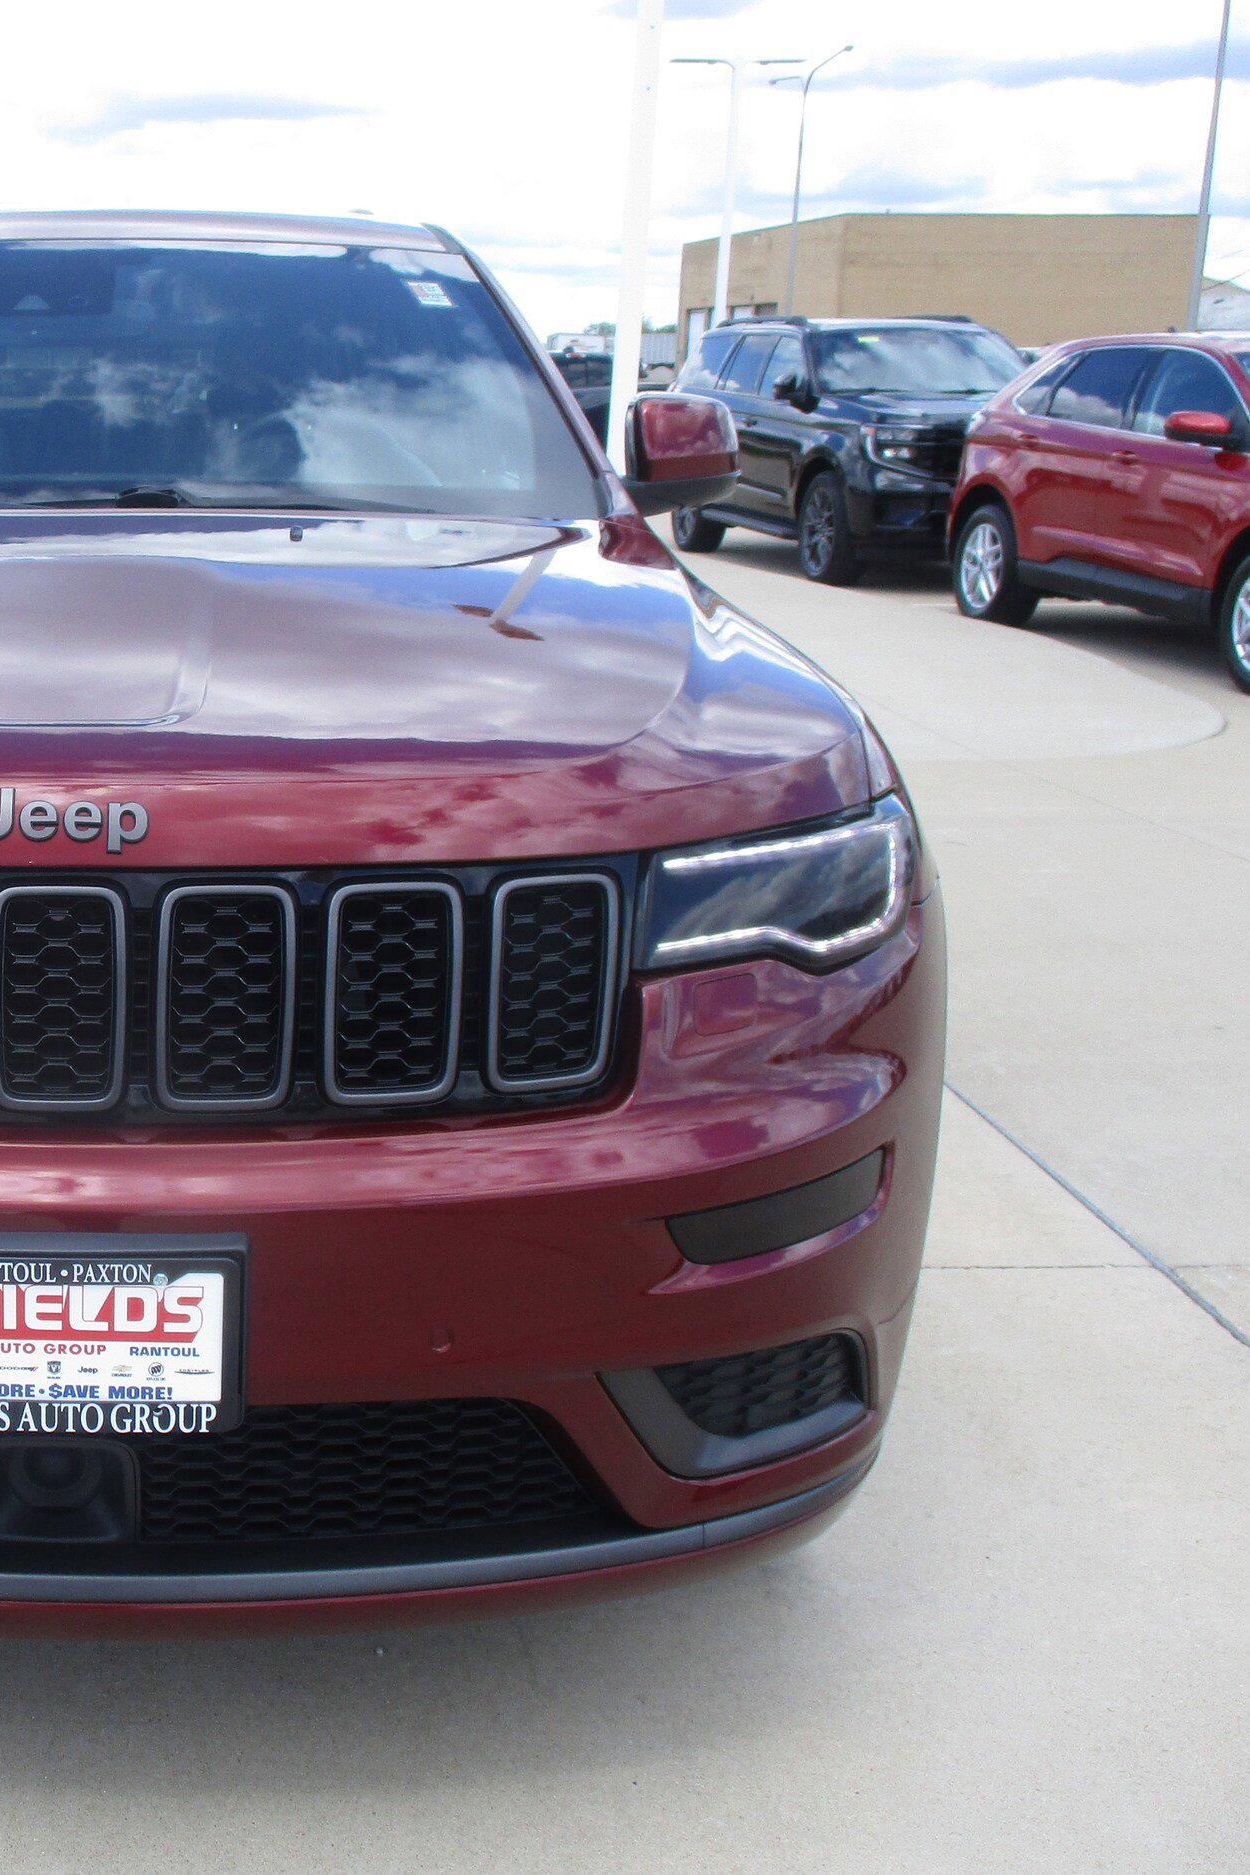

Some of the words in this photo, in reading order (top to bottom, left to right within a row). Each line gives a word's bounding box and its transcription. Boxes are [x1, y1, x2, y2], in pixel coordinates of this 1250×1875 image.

[72, 1264, 152, 1283] PAXTON
[44, 1344, 107, 1355] GROUP
[130, 1347, 200, 1357] RANTOUL
[78, 1366, 98, 1375] Jeep
[49, 1383, 99, 1399] $AVE
[109, 1385, 173, 1400] MORE!
[17, 1402, 104, 1433] AUTO
[110, 1403, 217, 1434] GROUP
